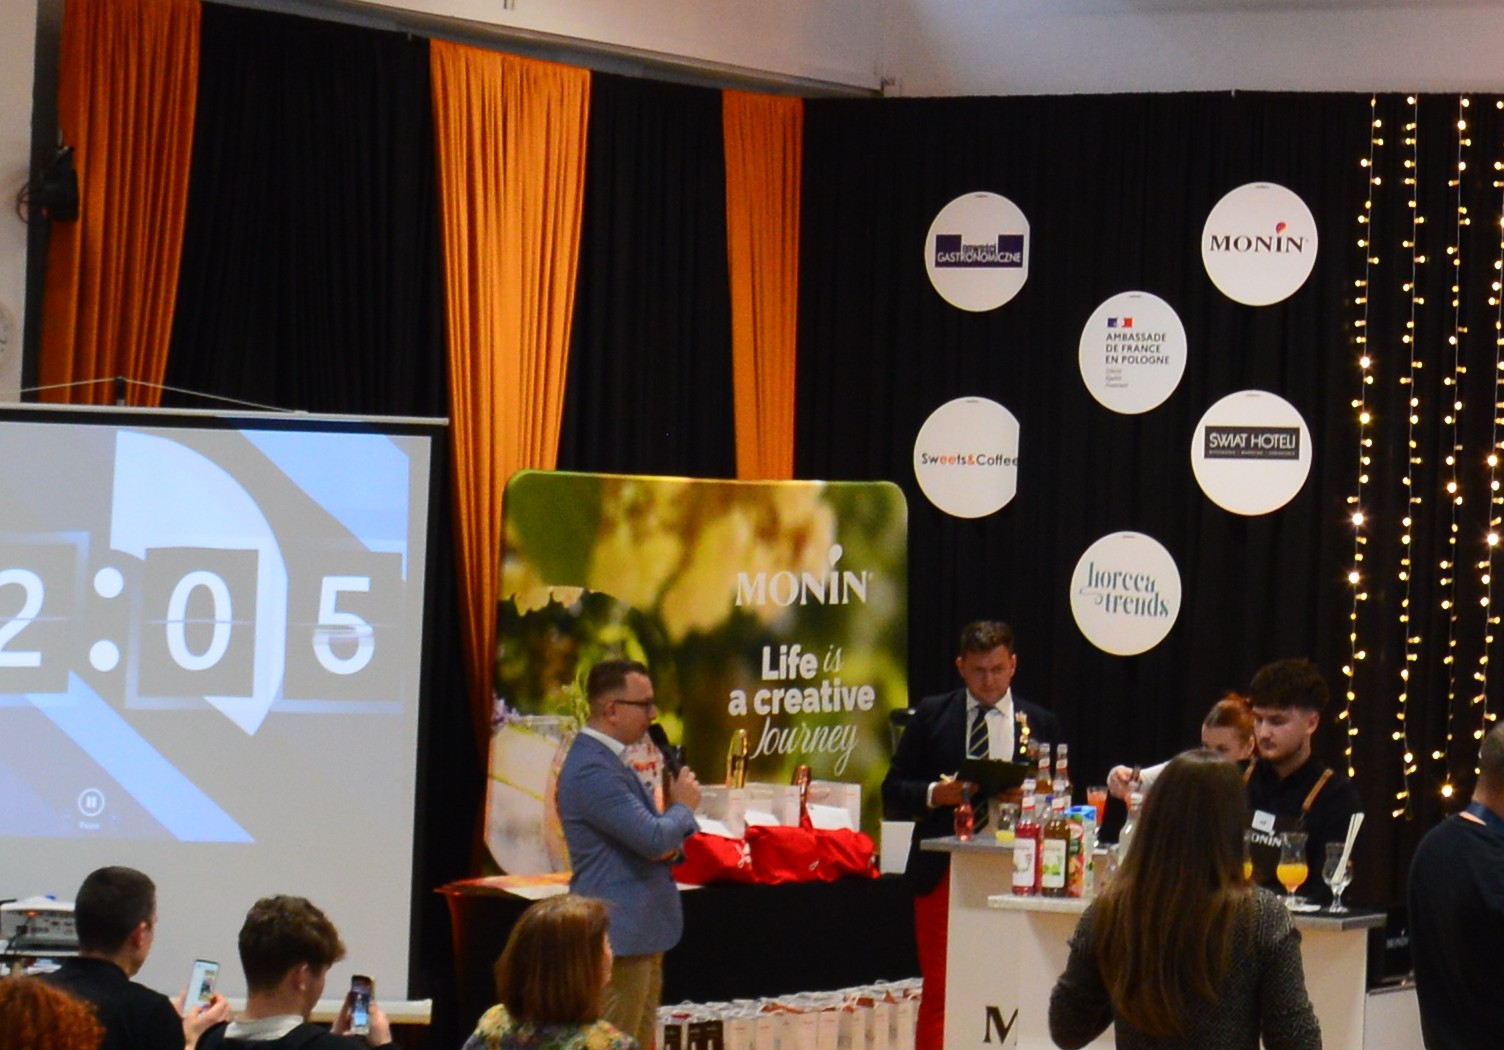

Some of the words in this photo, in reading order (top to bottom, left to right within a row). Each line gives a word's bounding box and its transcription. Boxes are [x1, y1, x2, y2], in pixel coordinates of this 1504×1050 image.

[1209, 222, 1304, 253] MONIN
[1105, 333, 1167, 342] AMBASSADE
[1105, 344, 1118, 353] DE
[1121, 344, 1161, 353] FRANCE
[1105, 355, 1119, 364] EN
[1121, 355, 1170, 365] POLOGNE
[735, 544, 869, 607] MONIN
[761, 644, 819, 682] Life
[823, 644, 844, 674] is
[727, 688, 747, 717] a
[753, 679, 876, 716] creative
[749, 716, 859, 776] Journey
